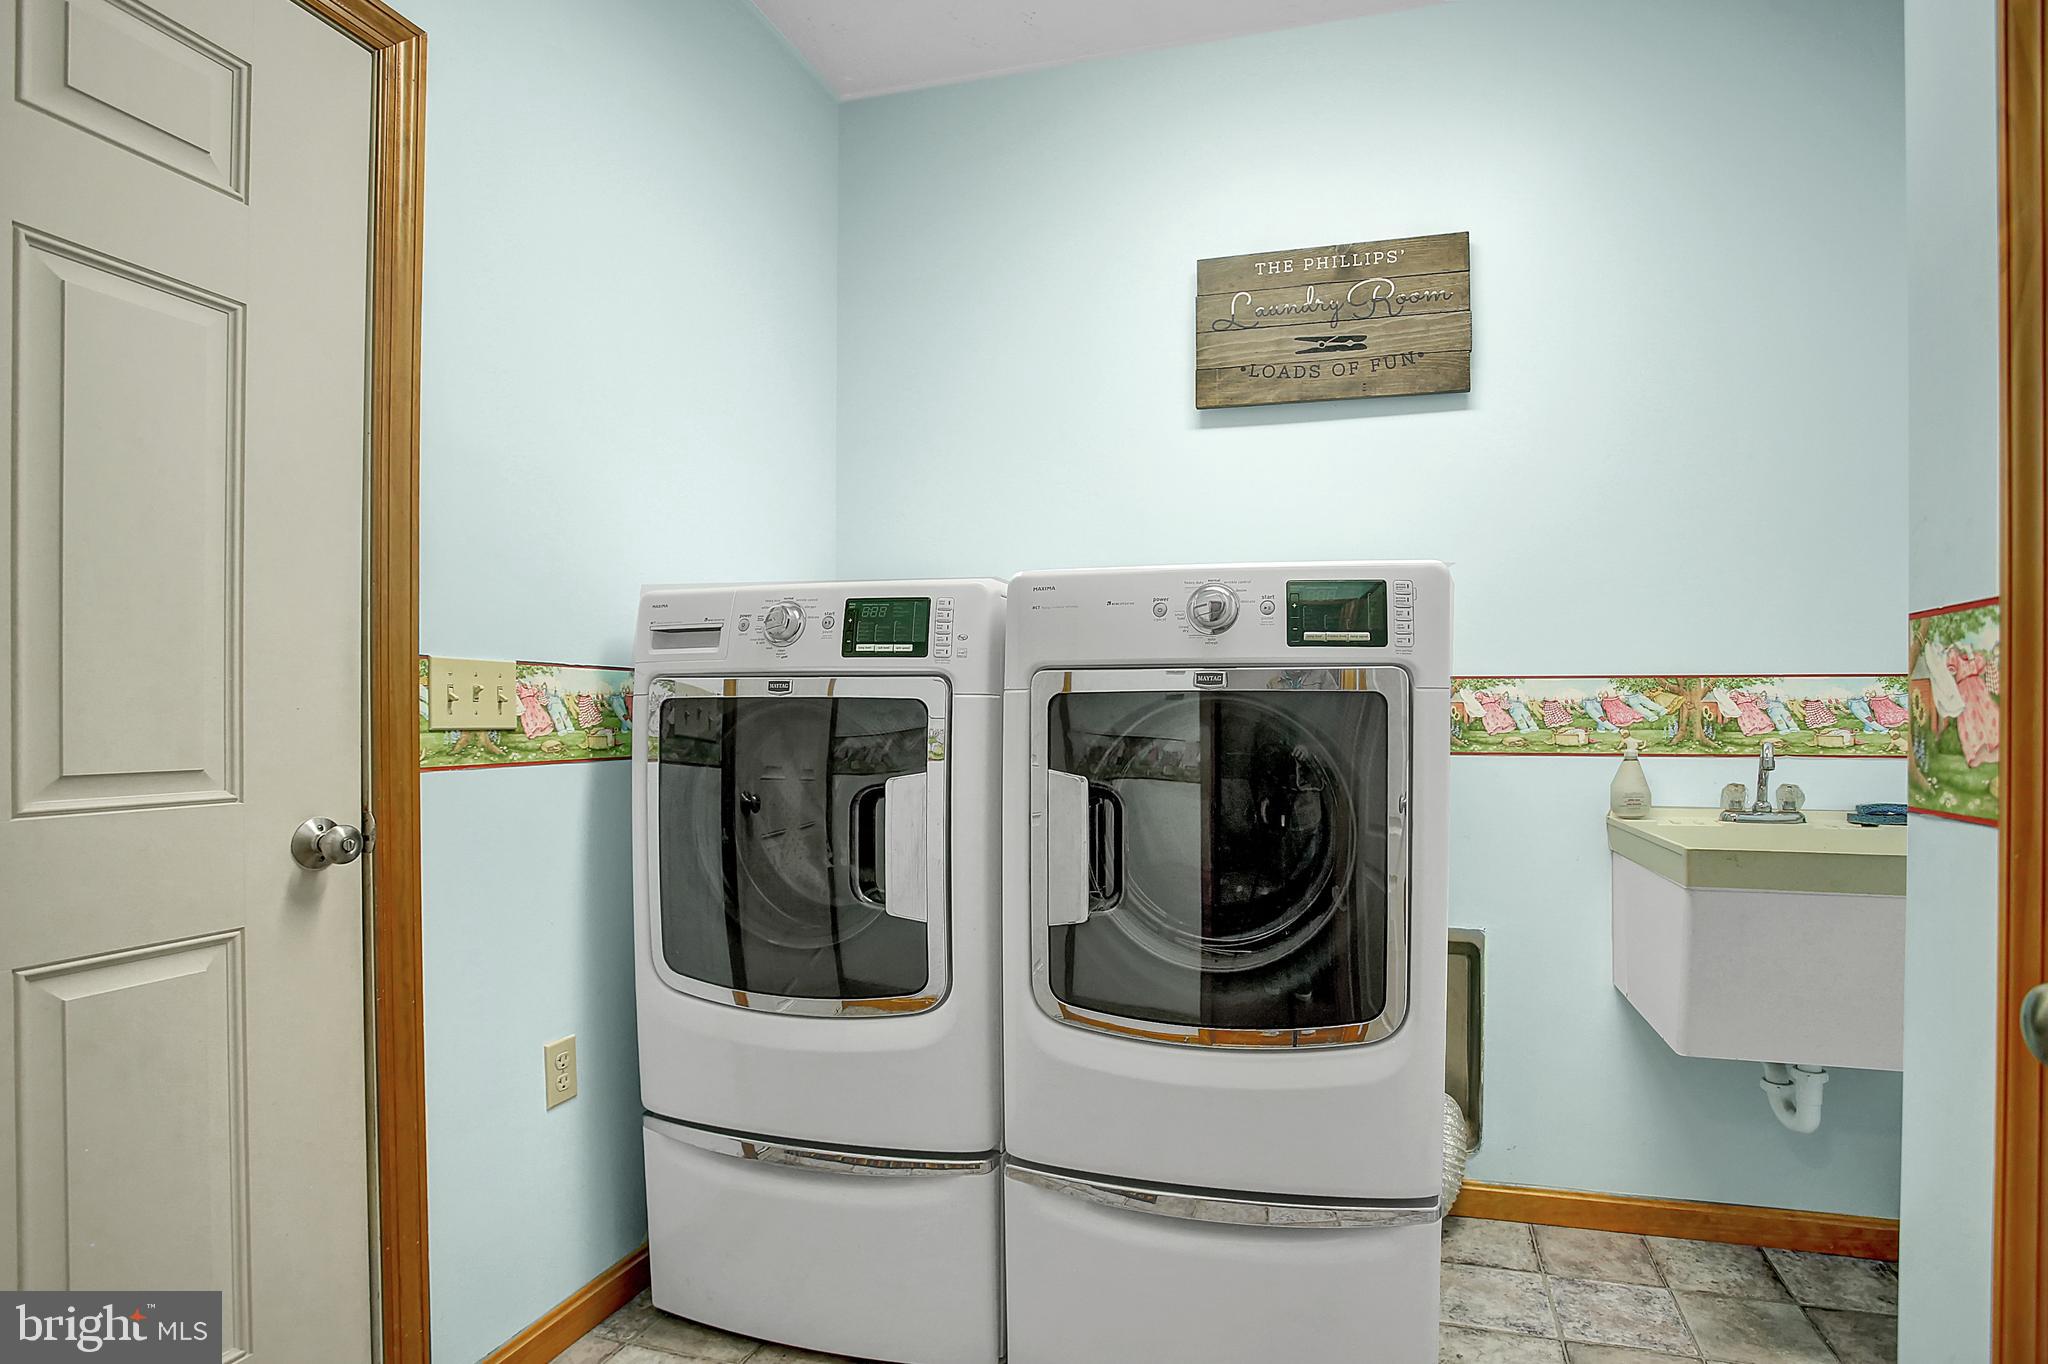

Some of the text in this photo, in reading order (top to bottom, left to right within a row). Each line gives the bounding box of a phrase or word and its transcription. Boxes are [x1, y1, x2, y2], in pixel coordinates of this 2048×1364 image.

[1254, 249, 1406, 276] THE PHILLIPS'
[1212, 277, 1454, 332] Laundry Room
[1248, 351, 1416, 379] LOADS OF FUN
